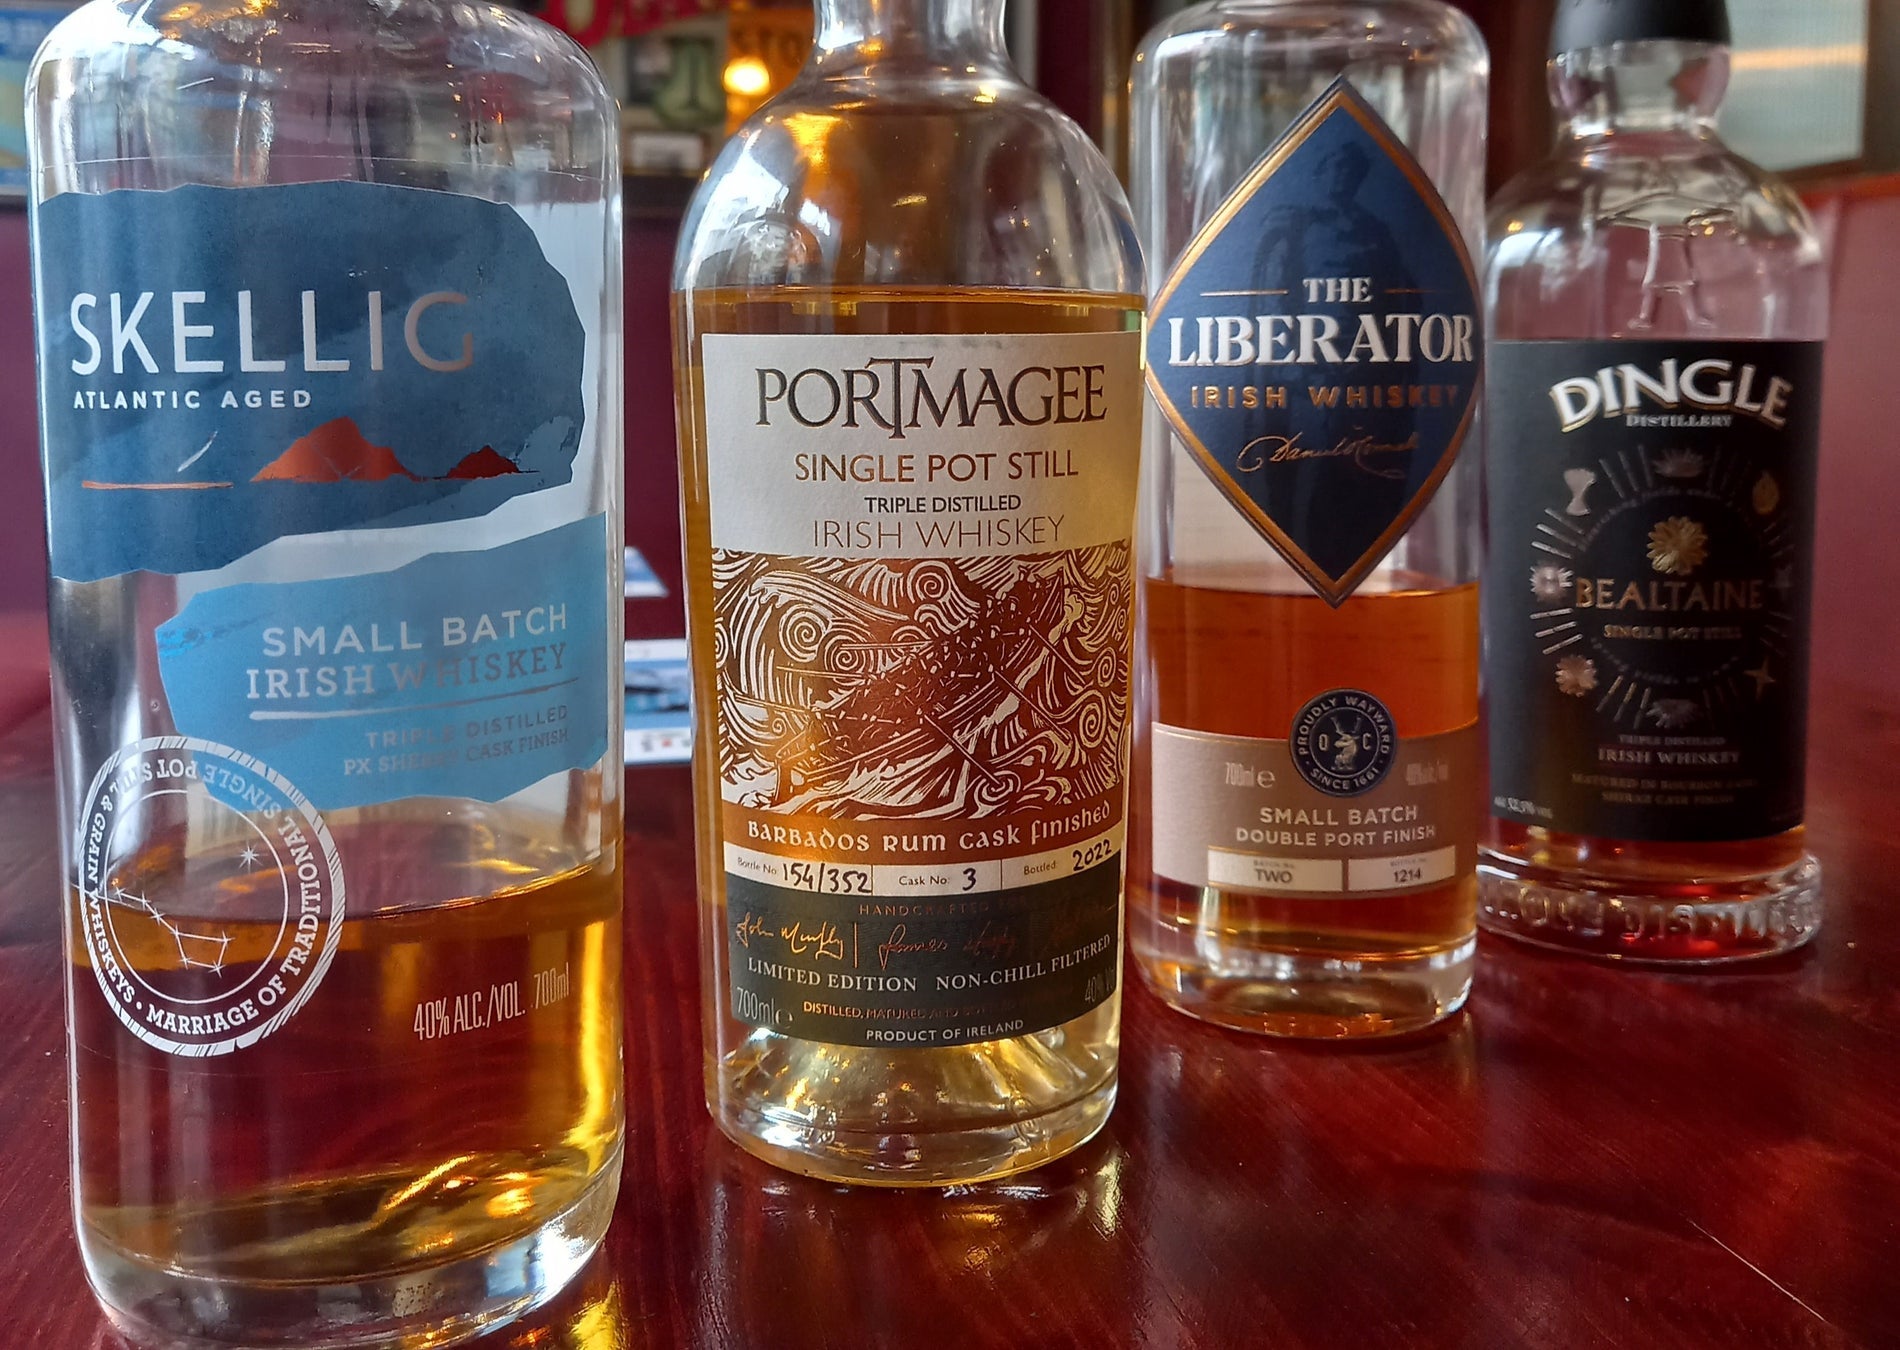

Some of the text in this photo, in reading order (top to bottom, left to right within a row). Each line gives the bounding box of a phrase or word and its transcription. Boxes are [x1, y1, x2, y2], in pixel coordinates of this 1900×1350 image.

[1302, 276, 1373, 304] THE
[70, 290, 473, 376] SKELLIG
[1168, 314, 1474, 367] LIBERATOR
[74, 389, 312, 410] ATLANTIC AGED
[755, 356, 1108, 440] PORTMAGEE
[1191, 385, 1459, 409] IRISH WHISKEY
[1549, 358, 1794, 433] DINGLE
[1626, 414, 1732, 427] DISTILLERY
[795, 449, 1079, 483] SINGLE POT STILL
[864, 494, 1021, 514] TRIPLE DISTILLED
[813, 514, 1065, 549] IRISH WHISKEY
[1576, 578, 1763, 611] BEALTAINE
[262, 603, 567, 657] SMALL BATCH
[247, 642, 567, 699] IRISH WHISKEY
[366, 704, 568, 749] TRIPLE DISTILLED
[1297, 695, 1390, 756] PROUDLY WAYWARD
[156, 758, 199, 780] POT
[344, 758, 372, 776] PX
[466, 740, 514, 762] CASK
[518, 728, 569, 753] FINISH
[202, 763, 282, 820] SINGLE
[1310, 768, 1350, 790] SINCE
[100, 794, 114, 812] &
[1260, 804, 1418, 826] SMALL BATCH
[88, 812, 106, 884] GRAIN
[1236, 824, 1436, 847] DOUBLE PORT FINISH
[1072, 838, 1113, 872] 2022
[782, 861, 872, 894] 154/352
[898, 875, 926, 886] Cask
[961, 867, 977, 892] 3
[1254, 868, 1294, 884] TWO
[1393, 868, 1422, 883] 1214
[278, 815, 321, 977] TRADITIONAL
[89, 887, 136, 1003] WHISKEYS
[748, 956, 821, 986] LIMITED
[828, 973, 917, 992] EDITION
[936, 962, 1047, 991] NON-CHILL
[1050, 933, 1111, 973] FILTERED
[257, 974, 287, 1006] OF
[736, 986, 775, 1025] 700ml
[146, 998, 260, 1035] MARRIAGE
[413, 997, 450, 1041] 40%
[453, 980, 526, 1034] ALC./VOL.
[866, 1018, 1024, 1042] PRODUCT OF IRELAND
